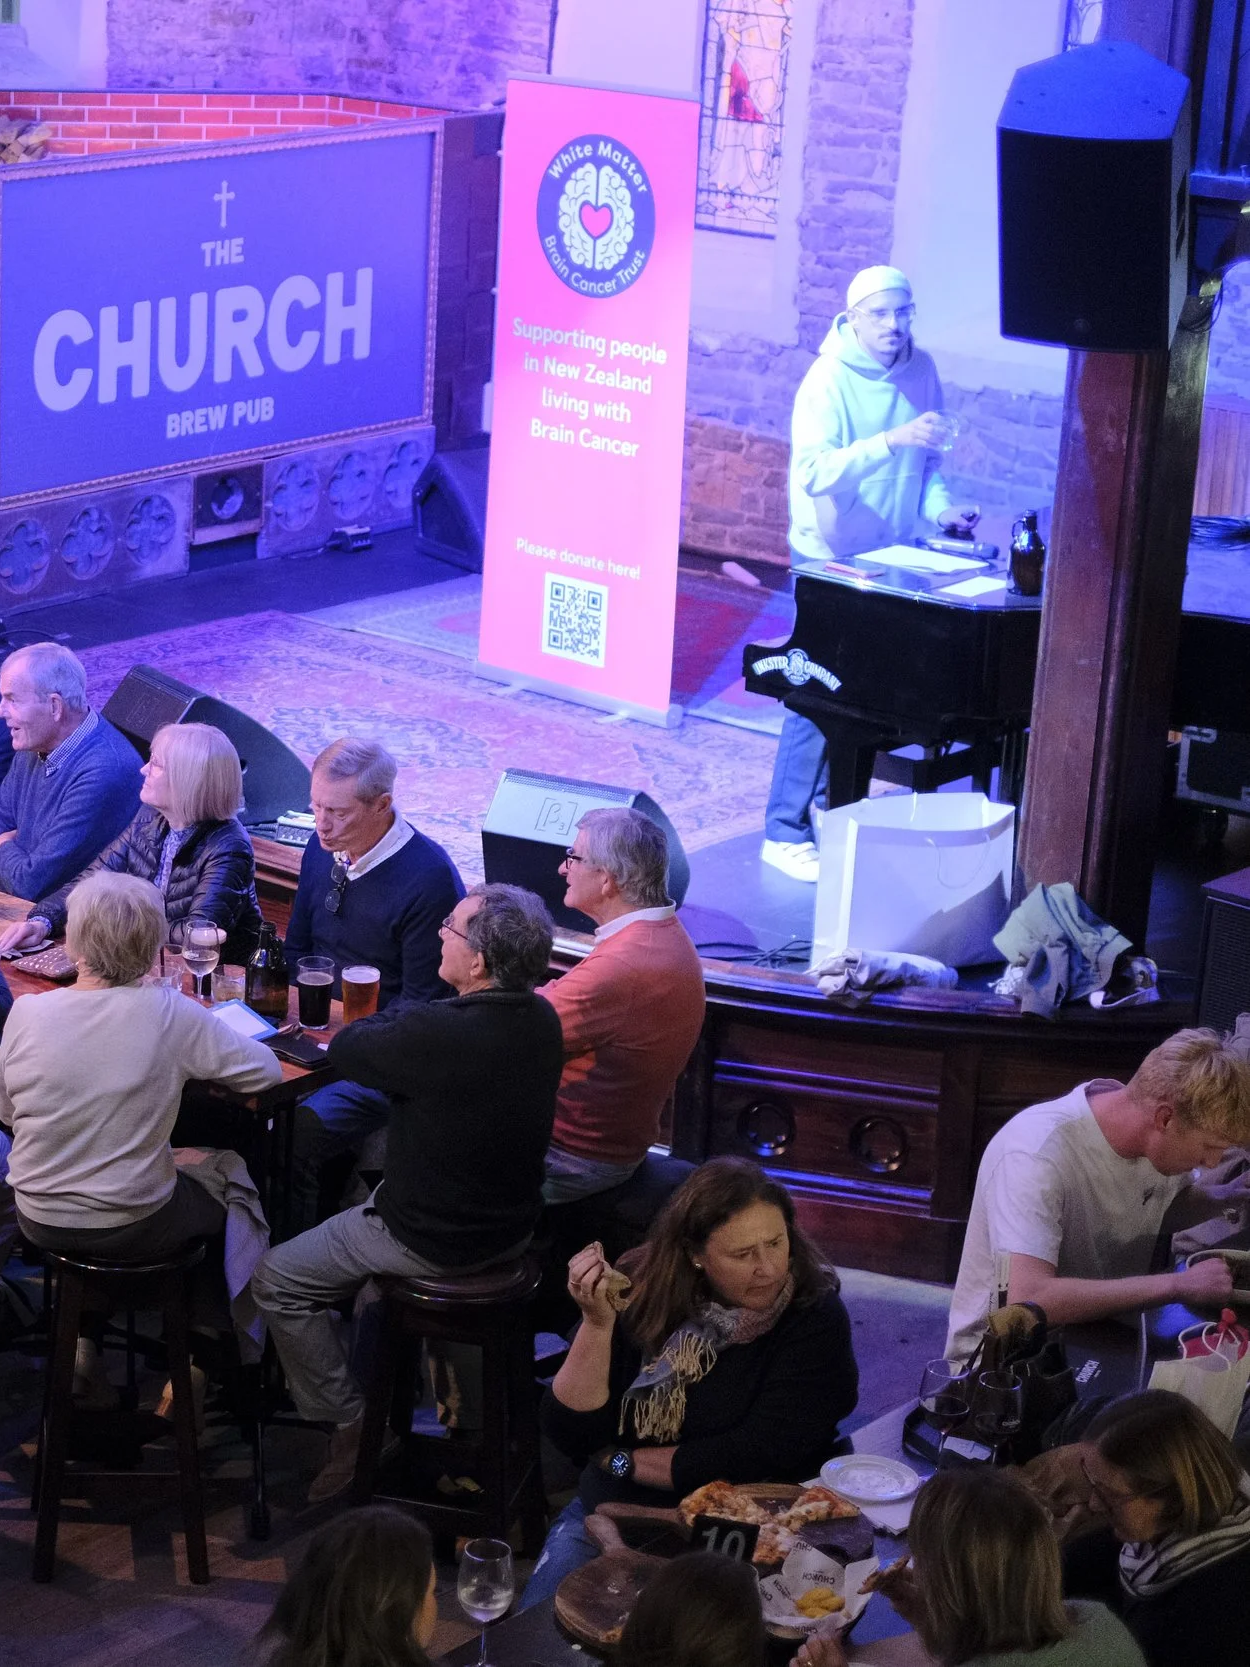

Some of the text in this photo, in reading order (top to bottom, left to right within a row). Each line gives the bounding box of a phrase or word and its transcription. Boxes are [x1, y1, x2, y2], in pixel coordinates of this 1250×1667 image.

[548, 140, 648, 193] White Matter
[200, 236, 246, 268] THE
[544, 234, 647, 294] Brain Cancer Trust
[32, 266, 374, 412] CHURCH
[512, 316, 668, 366] Supporting people
[523, 351, 653, 395] in New Zealand
[165, 396, 275, 440] BREW PUB
[541, 386, 632, 424] living with
[530, 416, 641, 457] Brain Cancer
[515, 536, 642, 581] Please donate here!
[804, 660, 842, 691] COMPANY
[1075, 1359, 1100, 1383] CHURCH
[701, 1525, 747, 1563] 10
[802, 1572, 836, 1585] CHURCH
